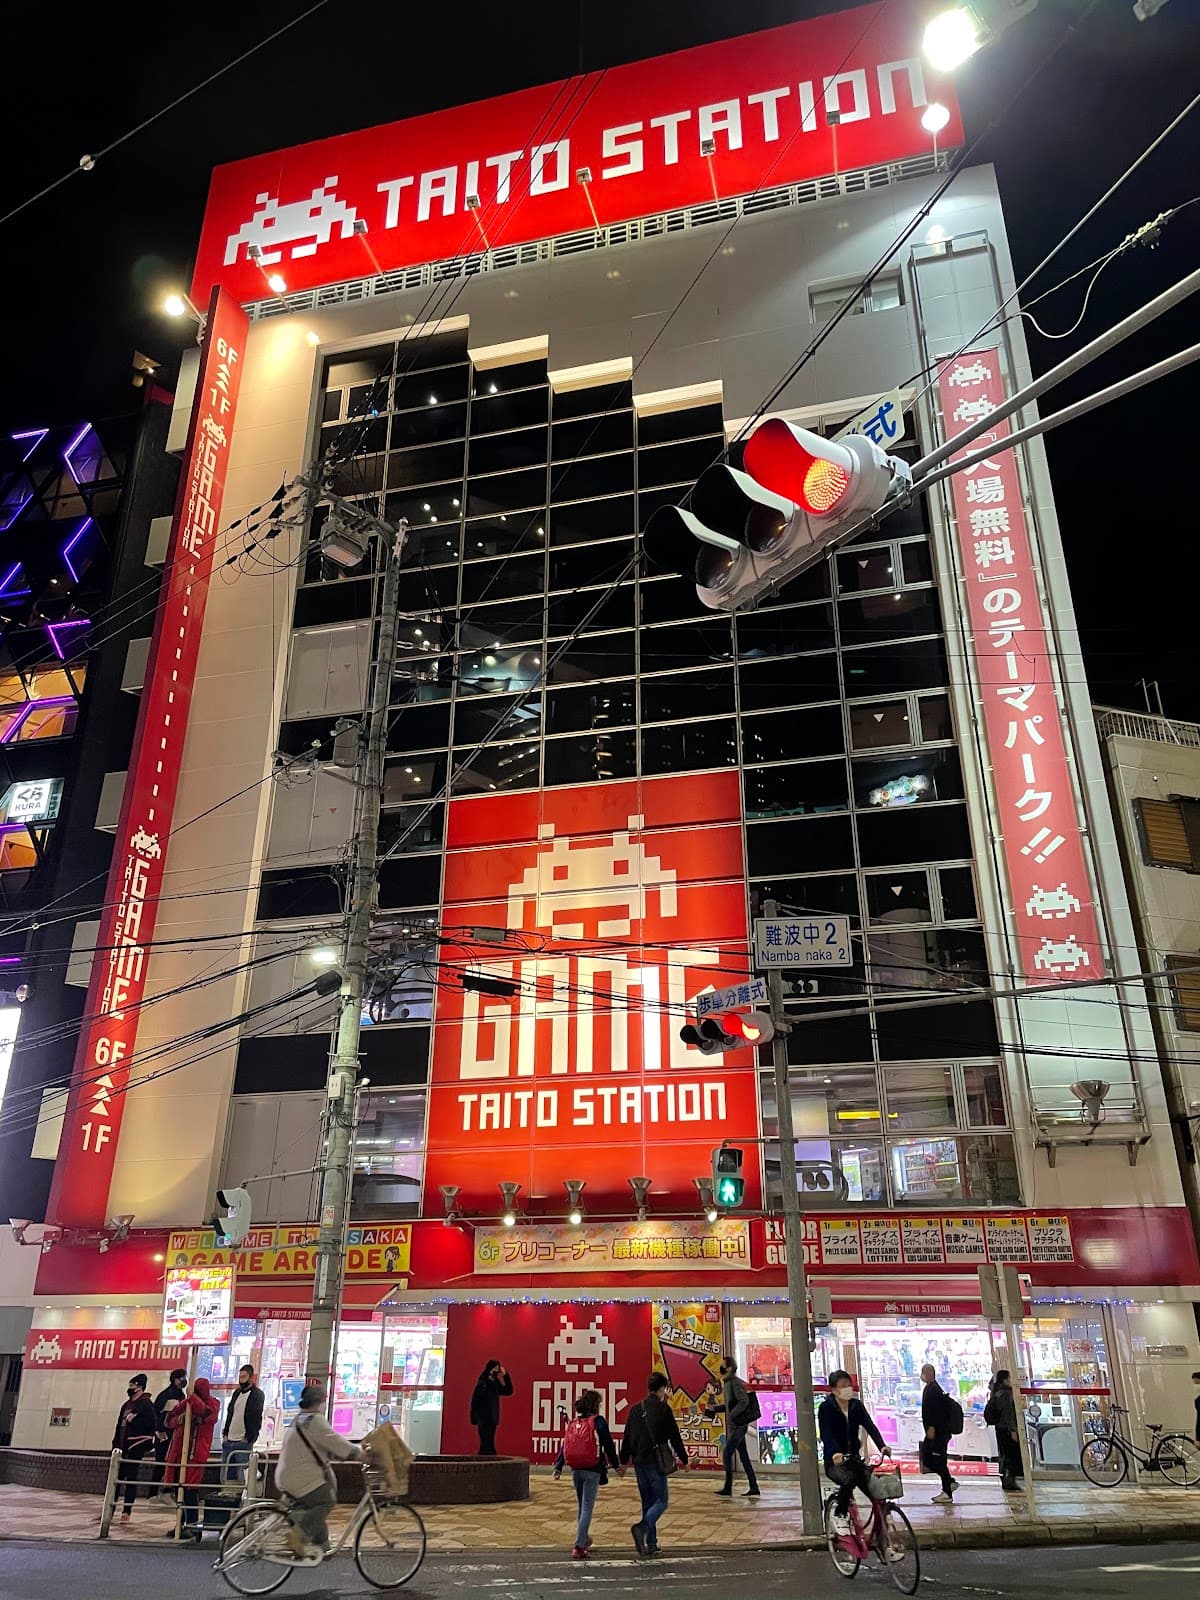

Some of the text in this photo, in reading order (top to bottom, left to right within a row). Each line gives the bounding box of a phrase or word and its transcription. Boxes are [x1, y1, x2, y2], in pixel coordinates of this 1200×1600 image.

[377, 57, 928, 229] TAITO STATION
[217, 338, 238, 367] 6F
[210, 388, 232, 415] 1F
[182, 431, 205, 549] TAITO STATION
[190, 438, 219, 560] GAME
[17, 787, 43, 802] くら
[15, 801, 41, 812] KURA
[100, 854, 135, 1015] TAITO STATION
[110, 858, 150, 1020] GAME
[765, 922, 837, 946] 難波中2
[761, 948, 846, 962] Namba naka 2
[459, 946, 725, 1080] GAME
[95, 1037, 126, 1068] 6F
[457, 1082, 726, 1131] TAITO STATION
[81, 1121, 112, 1153] 1F
[173, 1231, 272, 1249] WELCME
[349, 1230, 408, 1245] SAKA
[823, 1235, 858, 1245] プライズ
[862, 1230, 898, 1239] プライズ
[903, 1229, 939, 1237] プライズ
[945, 1233, 983, 1244] 音楽ゲーム
[1034, 1236, 1067, 1245] サテライト
[1035, 1228, 1063, 1236] プリクラ
[479, 1236, 745, 1262] 6F プリコーナー 最新機種稼働中!
[766, 1244, 820, 1265] GUDE
[946, 1245, 965, 1254] MUSIC
[966, 1244, 985, 1254] GAMES
[273, 1248, 382, 1272] ARDE
[900, 1304, 951, 1313] TAITO STATION
[74, 1339, 182, 1360] TAITO STATION
[675, 1413, 722, 1427] ーンゲーム
[679, 1427, 710, 1442] るで!!
[532, 1437, 565, 1454] TAIT
